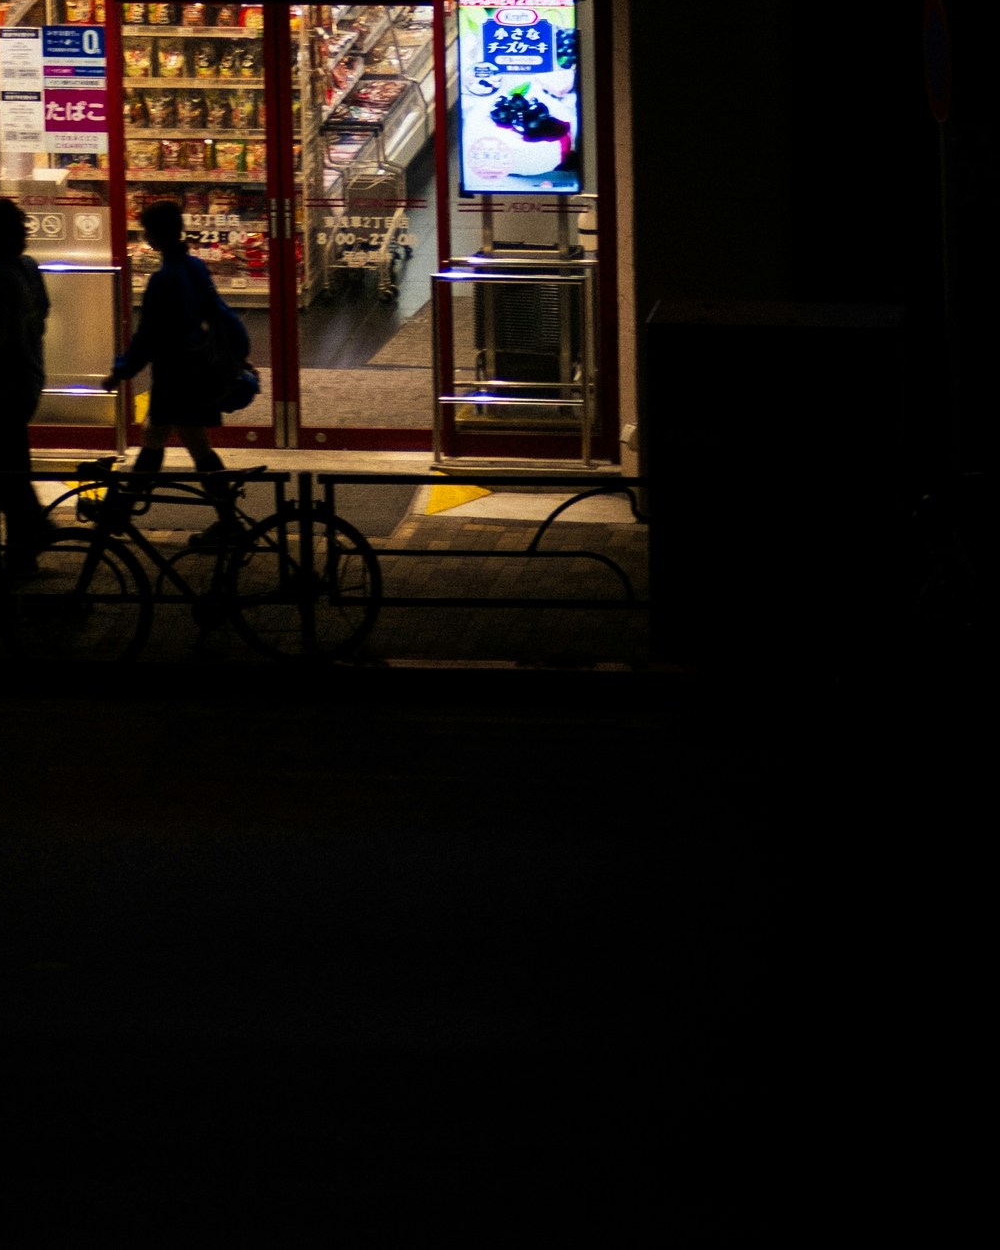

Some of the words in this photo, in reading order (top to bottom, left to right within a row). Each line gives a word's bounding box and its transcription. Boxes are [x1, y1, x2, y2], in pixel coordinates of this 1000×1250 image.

[493, 27, 541, 40] 小さな
[487, 41, 549, 53] チーズケーキ
[46, 100, 106, 121] たばこ
